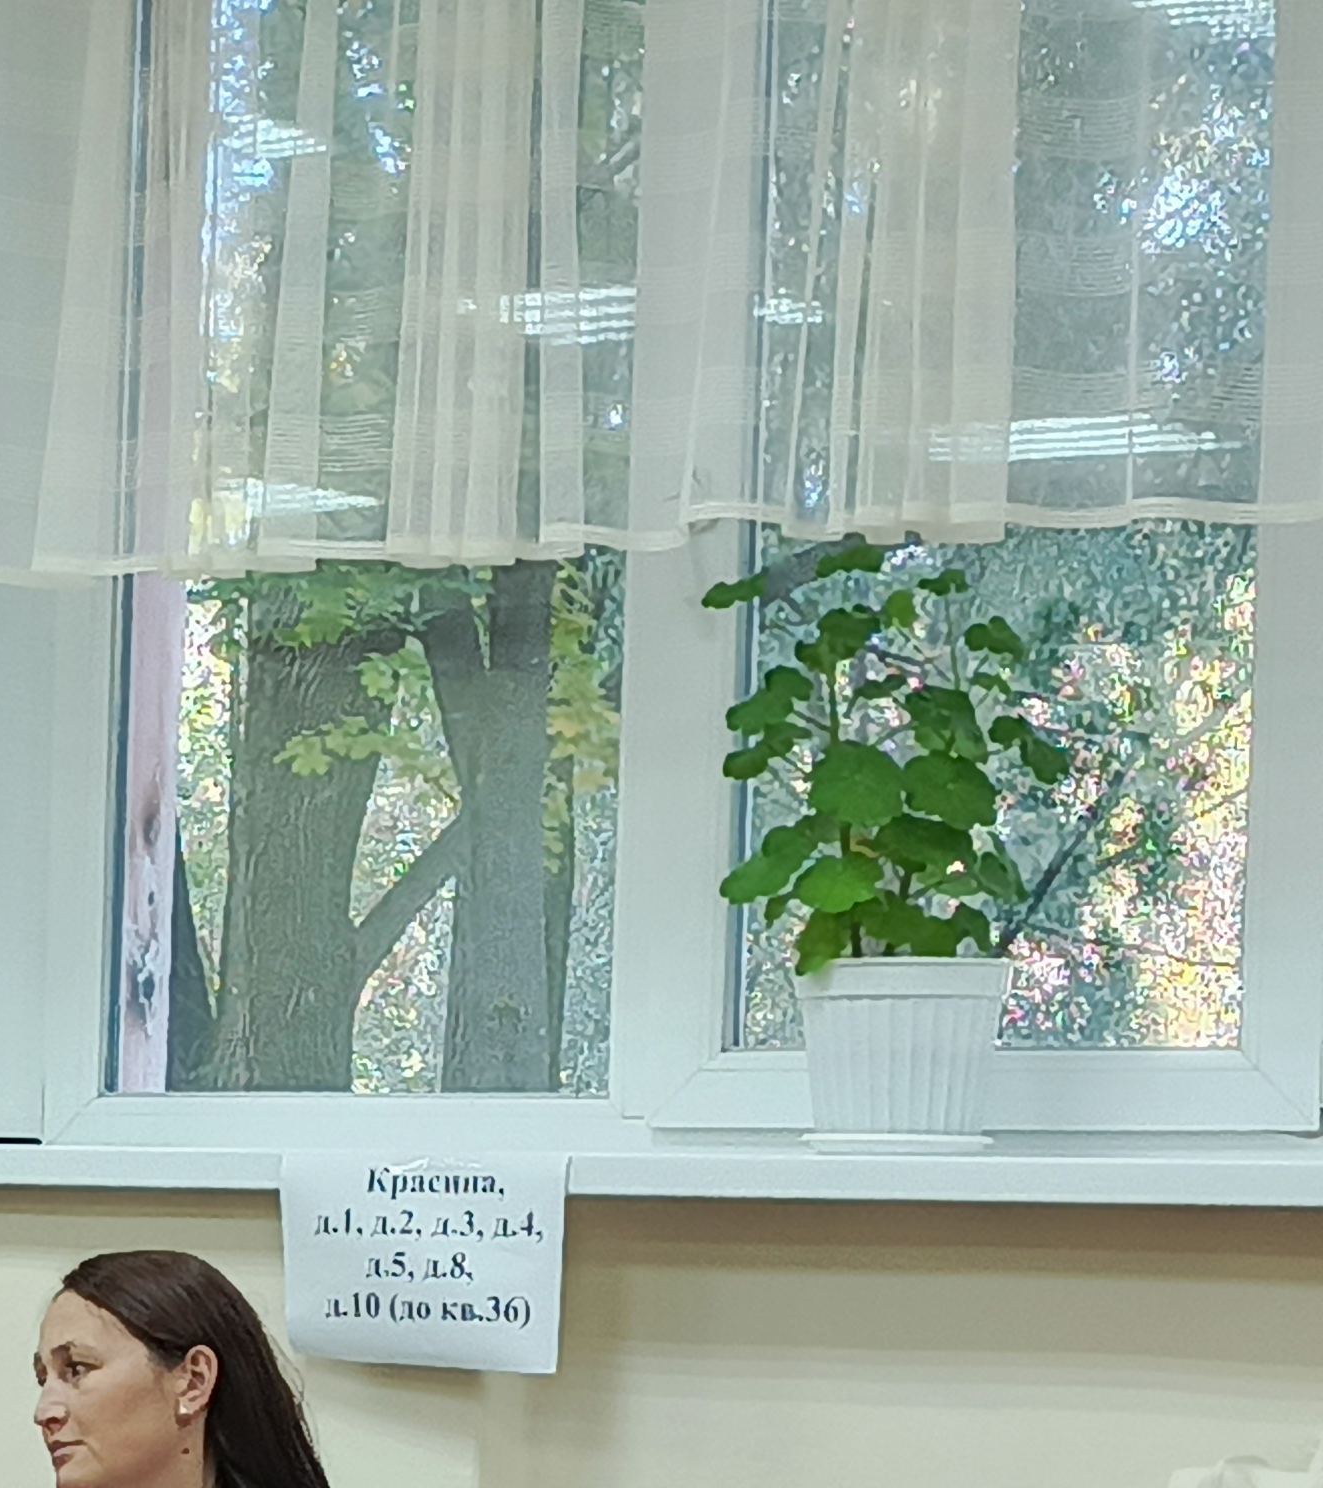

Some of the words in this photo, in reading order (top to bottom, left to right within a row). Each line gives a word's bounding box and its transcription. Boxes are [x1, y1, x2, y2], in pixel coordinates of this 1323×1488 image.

[366, 1167, 505, 1201] Красина,
[314, 1208, 363, 1236] д.1,
[370, 1209, 422, 1241] д.2,
[430, 1210, 484, 1241] д.3,
[491, 1208, 544, 1243] д.4,
[365, 1252, 414, 1281] д.5,
[422, 1252, 474, 1285] д.8,
[325, 1292, 380, 1319] д.10
[389, 1294, 431, 1324] (до
[441, 1296, 531, 1329] кв.36)
